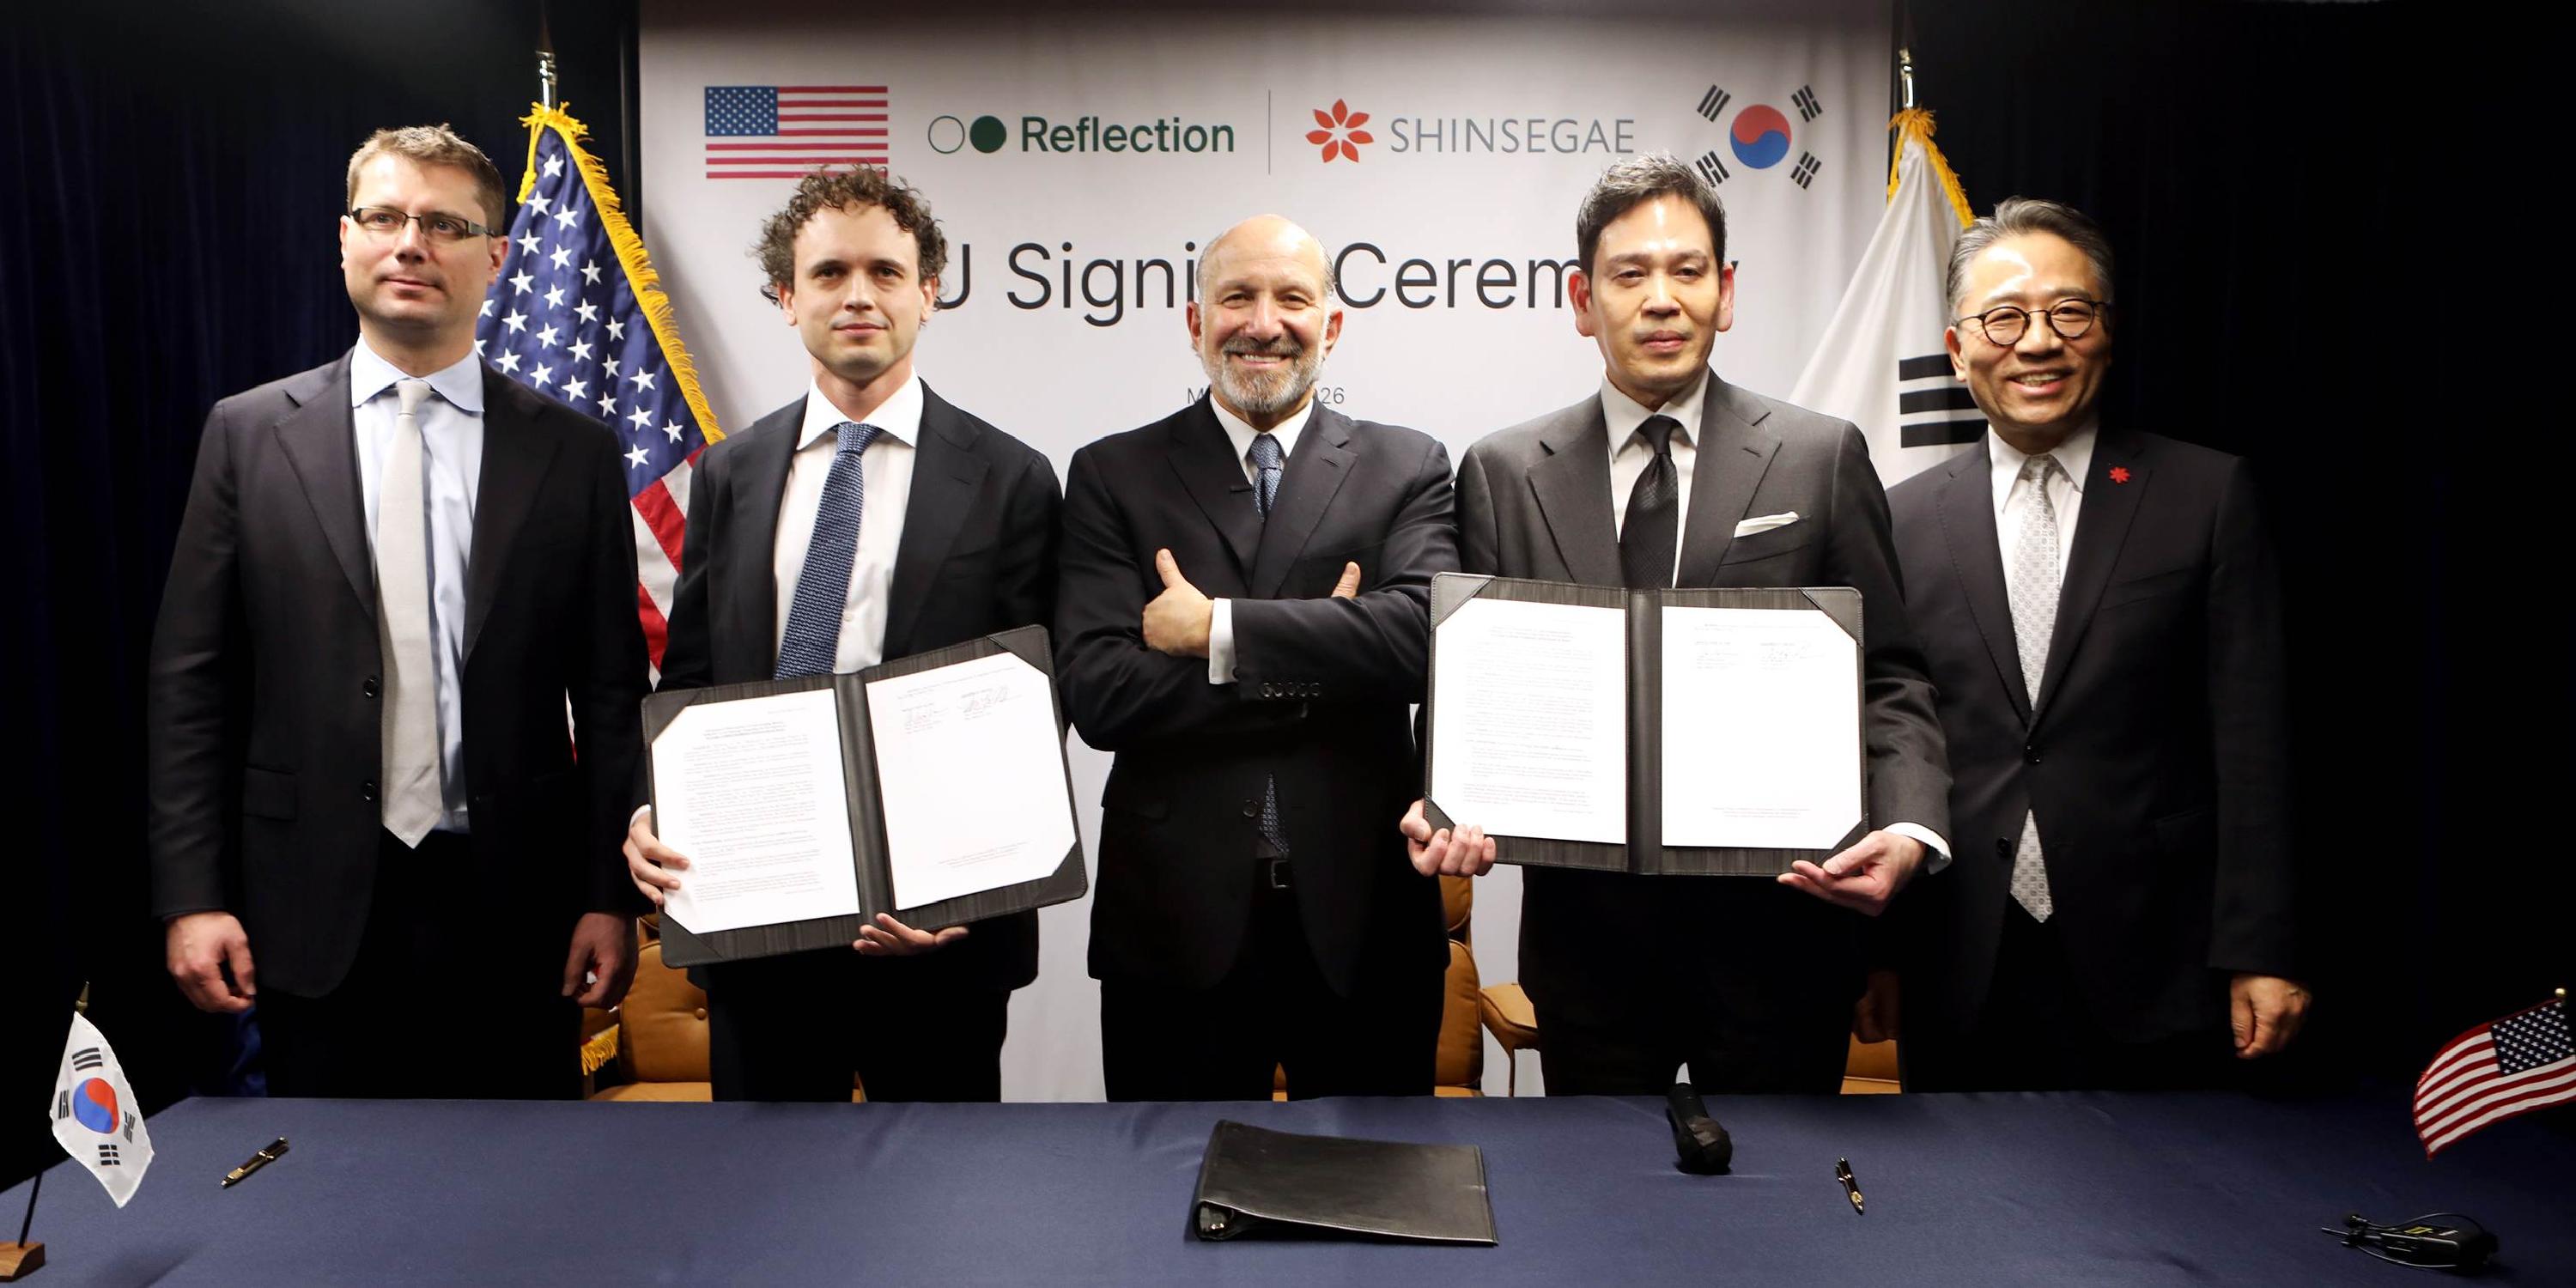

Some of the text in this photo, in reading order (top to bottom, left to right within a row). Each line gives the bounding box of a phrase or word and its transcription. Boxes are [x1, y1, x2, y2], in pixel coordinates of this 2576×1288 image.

[1021, 115, 1234, 154] Reflection
[1390, 118, 1635, 154] SHINSEGAE
[1006, 241, 1195, 327] Signi
[1334, 242, 1738, 309] Cerem
